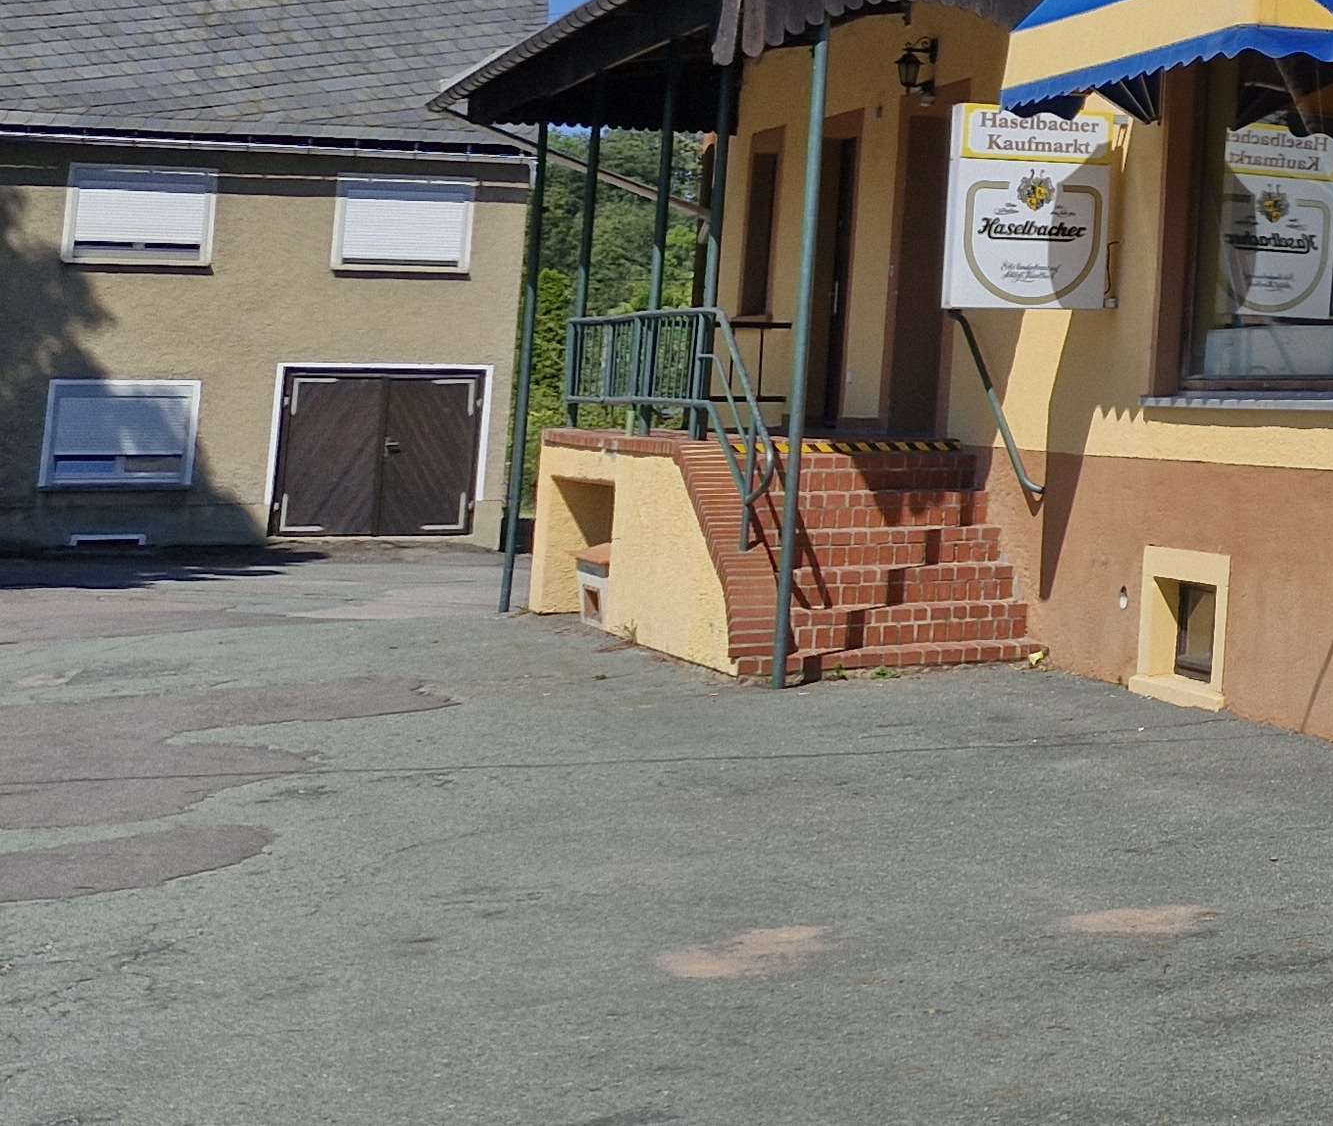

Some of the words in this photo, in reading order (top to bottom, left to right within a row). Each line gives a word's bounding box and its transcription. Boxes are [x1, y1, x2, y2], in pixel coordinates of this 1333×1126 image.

[980, 111, 1099, 133] Haselbacher
[987, 134, 1091, 154] Kaufmarkt
[977, 216, 1087, 242] Haselbacher
